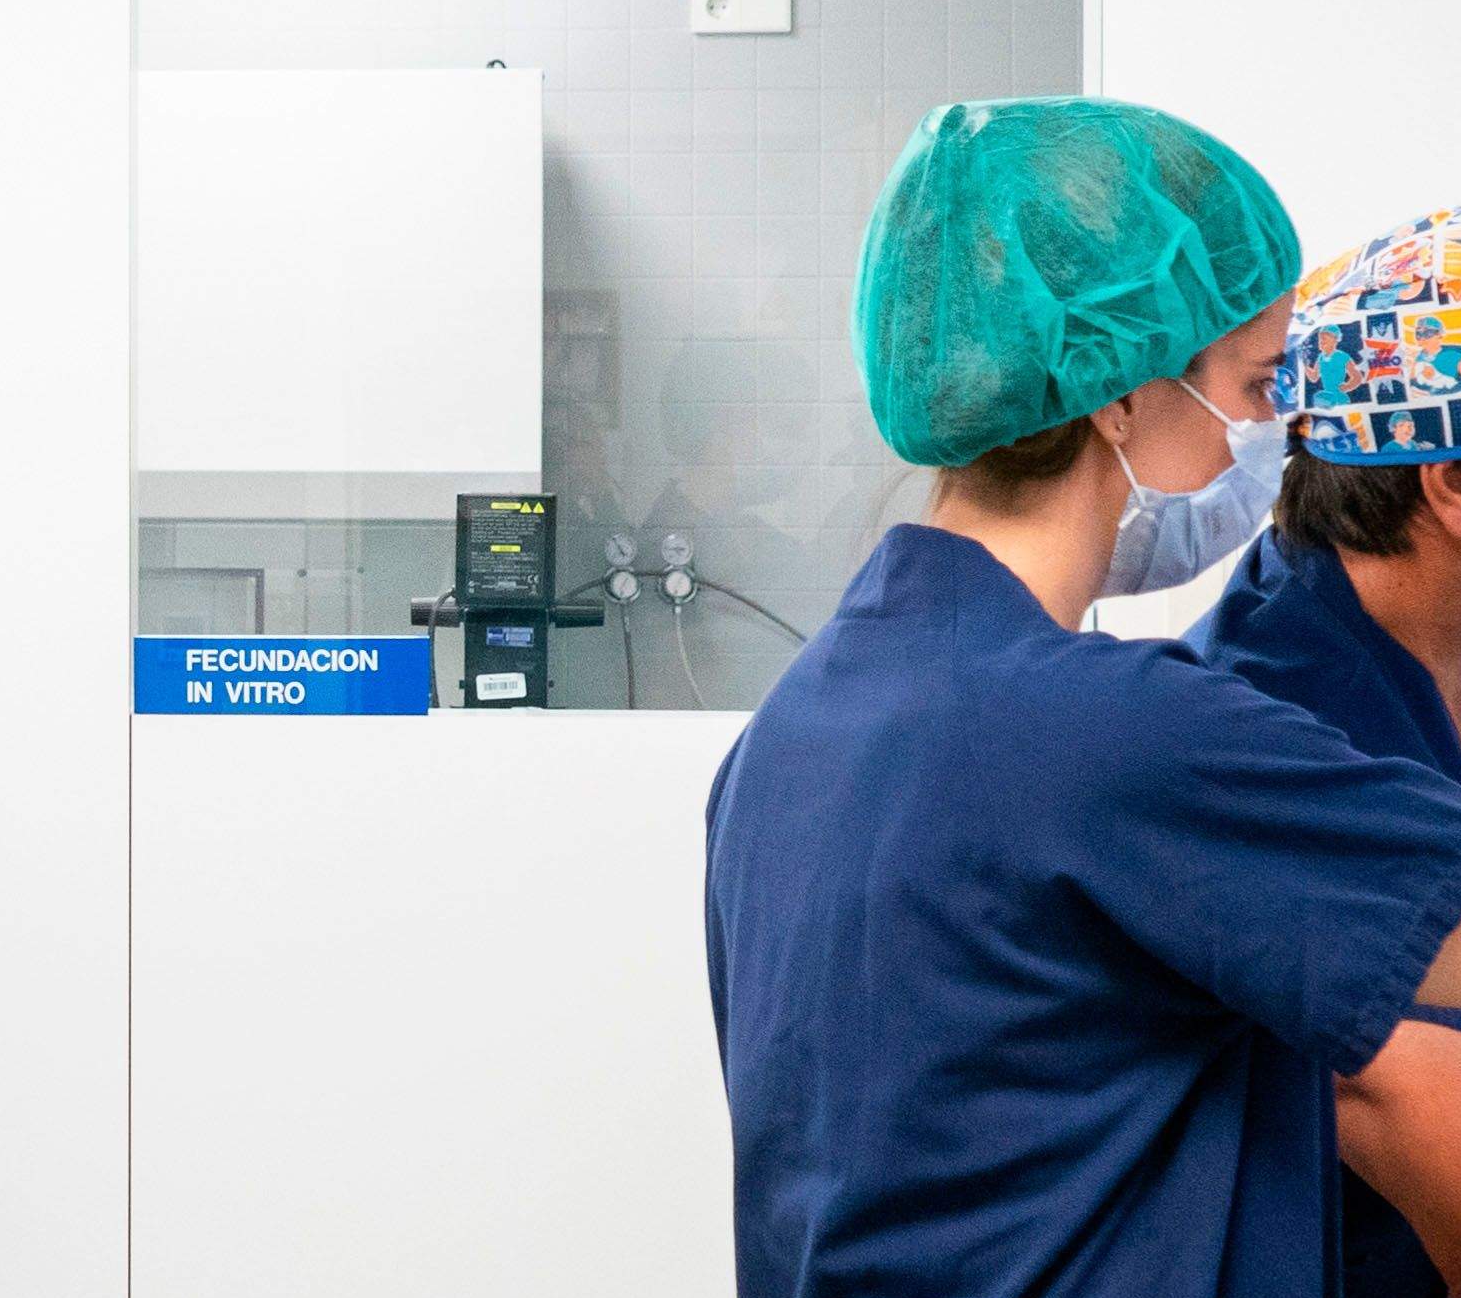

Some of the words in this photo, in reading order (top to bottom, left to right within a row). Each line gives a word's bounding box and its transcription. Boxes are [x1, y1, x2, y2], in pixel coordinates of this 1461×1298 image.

[185, 649, 378, 673] FECUNDACION
[186, 680, 213, 704] IN
[224, 680, 306, 705] VITRO
